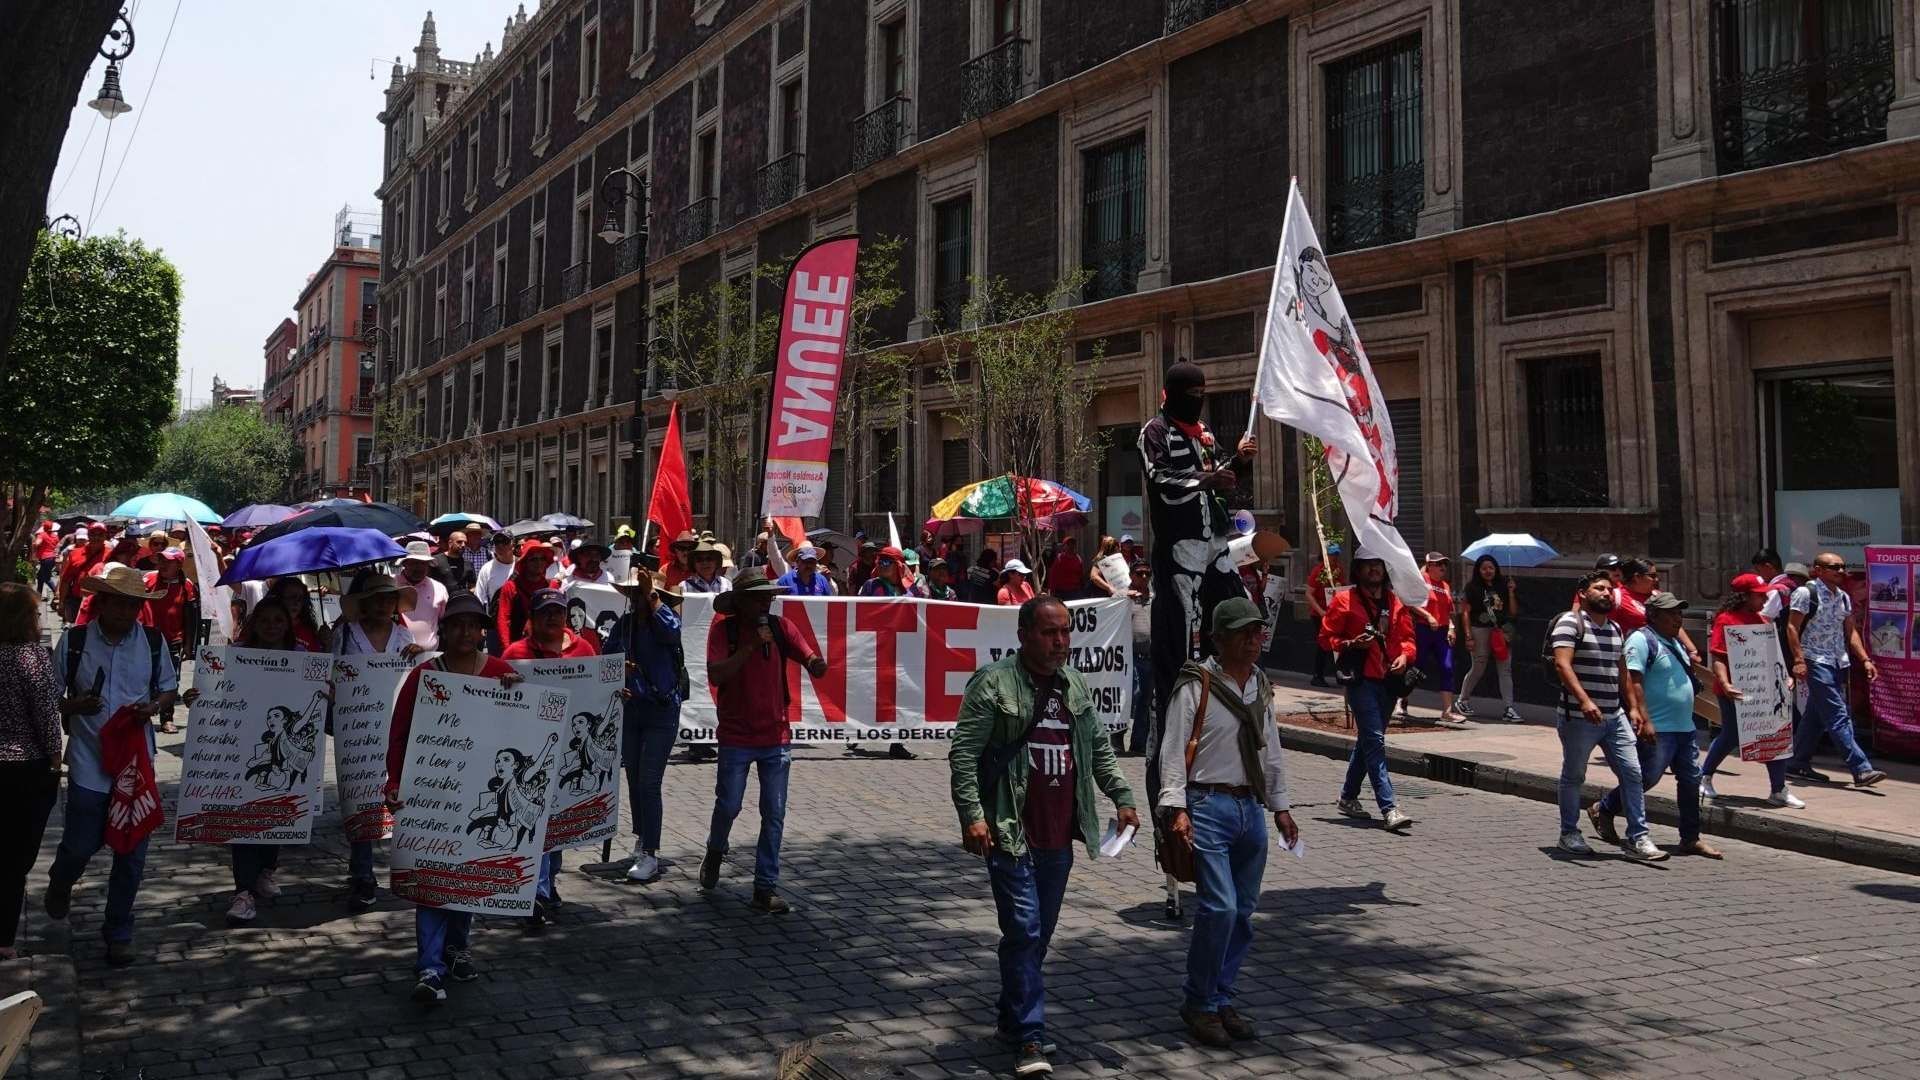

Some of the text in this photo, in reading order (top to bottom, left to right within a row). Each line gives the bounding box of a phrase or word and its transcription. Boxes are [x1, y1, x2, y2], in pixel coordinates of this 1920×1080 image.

[1876, 554, 1907, 562] TOURS
[1068, 607, 1098, 633] DOS
[235, 655, 289, 668] Sección 9
[707, 600, 979, 723] NTE
[303, 668, 329, 680] 2024
[533, 663, 586, 676] Sección 9
[601, 670, 623, 681] 2024
[215, 679, 236, 692] Me
[352, 686, 370, 697] Me
[462, 683, 524, 702] Sección 9
[197, 699, 248, 711] enseñaste
[339, 701, 385, 715] enseñaste
[540, 705, 565, 719] 2024
[209, 714, 228, 726] leer
[352, 719, 369, 730] leer
[437, 713, 463, 728] Me
[857, 728, 895, 740] LOS
[416, 733, 474, 752] enseñaste
[191, 749, 241, 763] ahora me
[429, 753, 450, 769] leer
[457, 761, 466, 773] y
[187, 768, 229, 781] enseñas
[413, 775, 462, 794] escribir,
[406, 793, 463, 813] ahora me
[401, 817, 450, 834] enseñas
[396, 833, 463, 857] LUCHAR.
[482, 897, 532, 911] VENCEREMOS!
